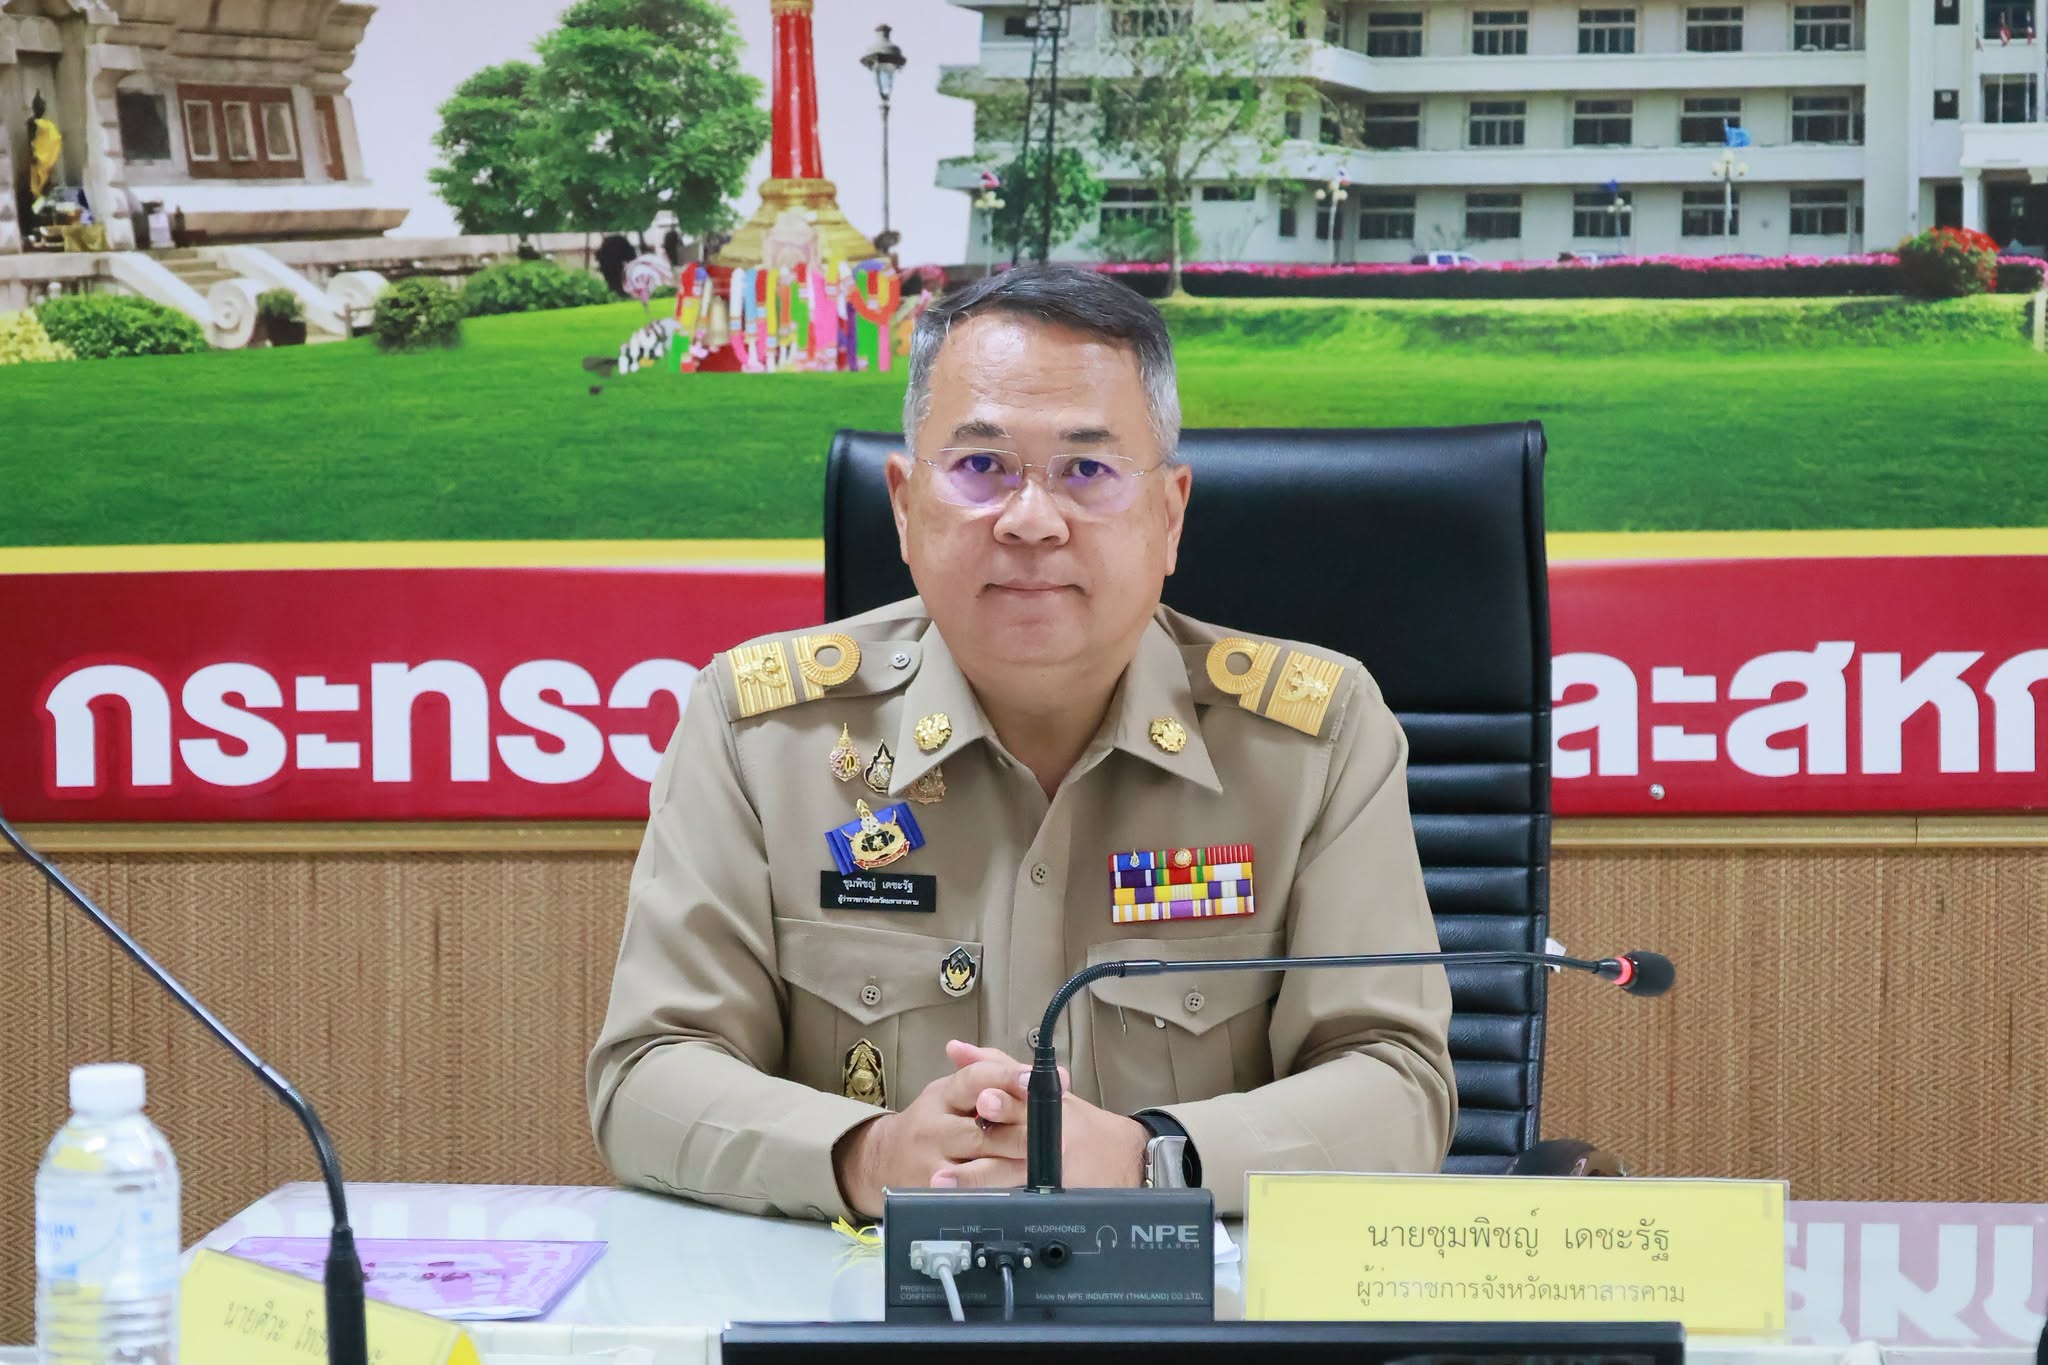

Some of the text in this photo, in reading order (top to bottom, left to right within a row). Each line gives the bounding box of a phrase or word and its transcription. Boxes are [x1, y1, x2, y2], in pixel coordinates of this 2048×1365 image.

[962, 1225, 982, 1234] LINE
[1024, 1224, 1087, 1234] HEADPHONES
[1131, 1225, 1200, 1243] NPE
[1367, 1207, 1670, 1262] นายชุมพิชญ์ เดชะรัฐ
[1356, 1264, 1685, 1306] ผู้ว่าราชการจังหวัดมหาสารคาม
[1035, 1291, 1056, 1301] Made
[1056, 1291, 1066, 1303] by
[1067, 1291, 1084, 1301] NPE
[1085, 1291, 1125, 1301] INDUSTRY
[1126, 1291, 1170, 1302] (THAILAND)
